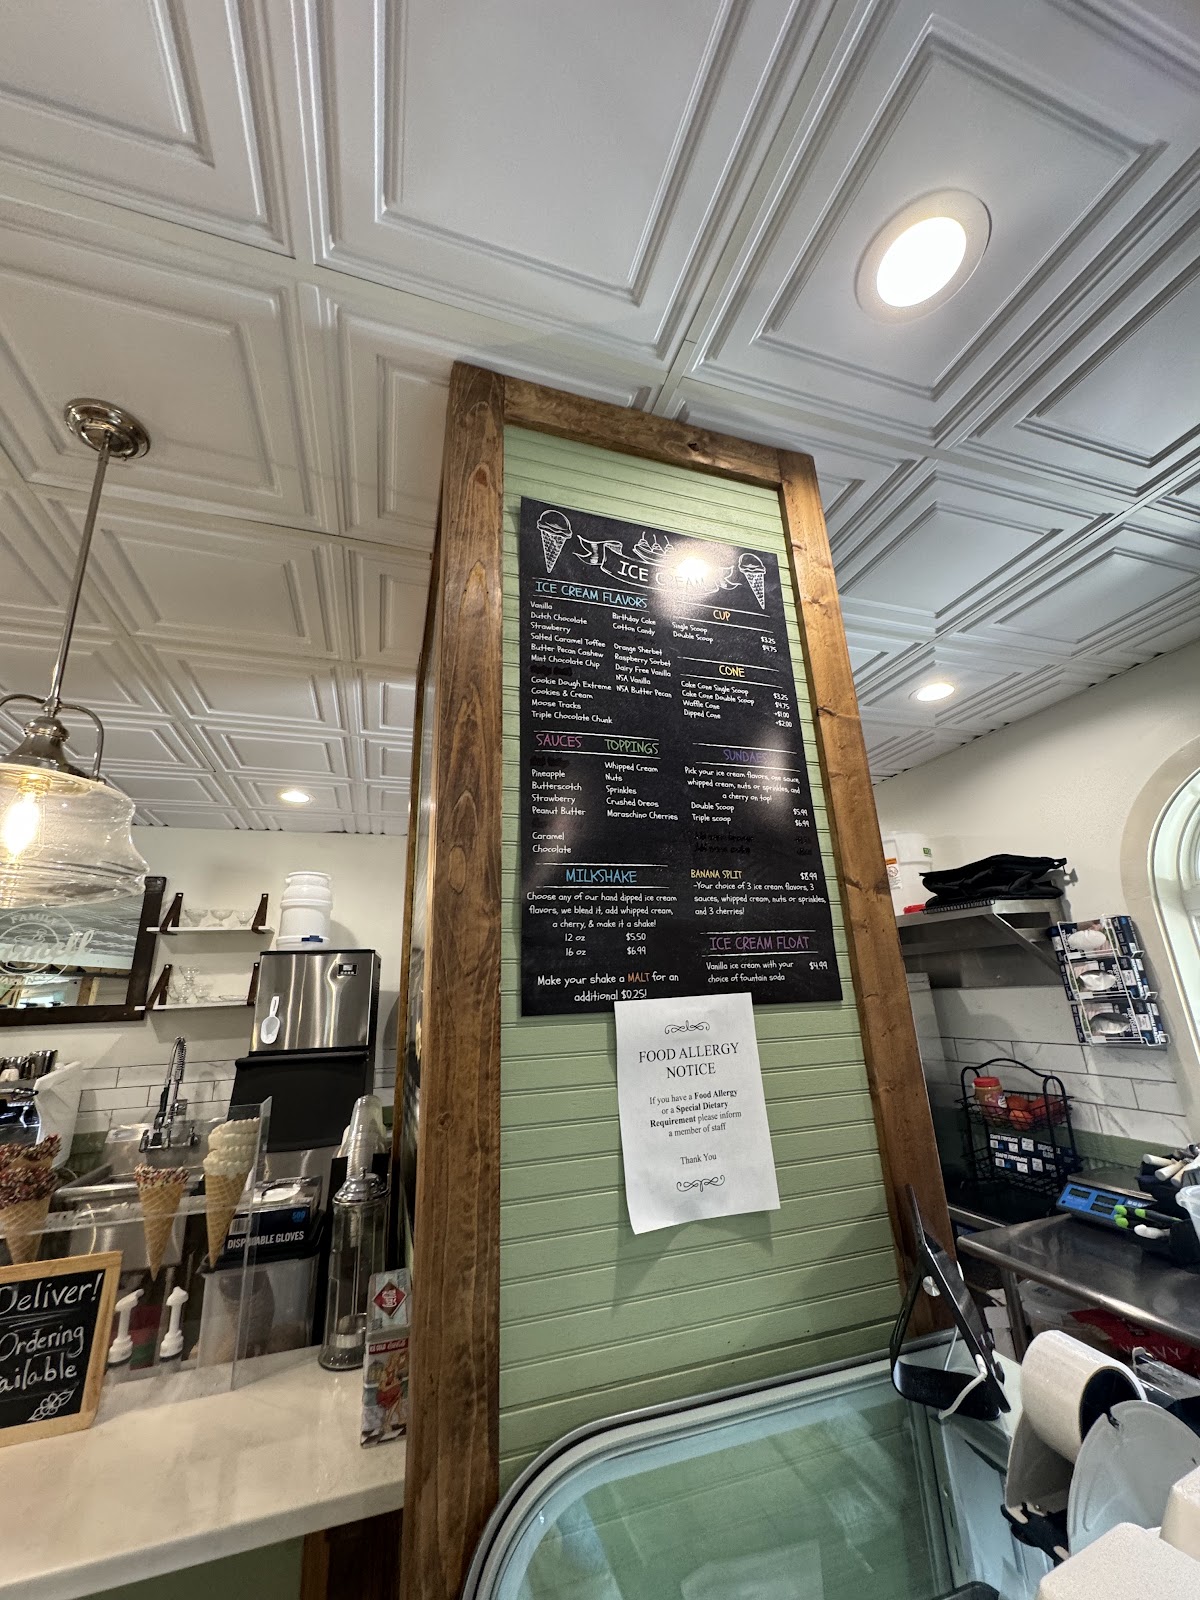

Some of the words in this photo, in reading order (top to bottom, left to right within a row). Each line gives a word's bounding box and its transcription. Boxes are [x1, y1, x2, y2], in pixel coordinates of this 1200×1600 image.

[618, 560, 649, 581] ICE
[535, 581, 556, 592] ICE
[562, 586, 598, 600] CREAM
[603, 592, 648, 608] FLAVORS
[530, 602, 552, 610] Vanilla
[531, 612, 551, 620] Dutch
[554, 615, 587, 624] Chocolate
[612, 613, 639, 624] Birthday
[641, 617, 656, 625] Cake
[713, 610, 730, 621] CUP
[531, 623, 571, 634] Strawberry
[613, 623, 635, 632] Cotton
[637, 627, 655, 636] Candy
[672, 622, 688, 633] Single
[690, 625, 708, 634] Scoop
[531, 633, 552, 641] Salted
[554, 636, 582, 644] Caramel
[585, 639, 606, 648] Toffee
[673, 631, 694, 640] Double
[696, 634, 713, 644] Scoop
[531, 644, 554, 652] Butter
[558, 646, 576, 654] Pecan
[578, 649, 604, 658] Cashew
[614, 643, 636, 653] Orange
[638, 646, 662, 656] Sherbet
[548, 656, 583, 666] Chocolate
[585, 660, 600, 669] Chip
[615, 653, 648, 666] Raspberry
[649, 658, 671, 667] Sorbet
[615, 664, 633, 674] Dairy
[635, 666, 649, 674] Free
[651, 668, 671, 677] Vanilla
[719, 665, 746, 677] CONE
[558, 679, 580, 689] Dough
[583, 682, 612, 691] Extreme
[531, 687, 560, 696] Cookies
[570, 691, 593, 699] Cream
[617, 685, 629, 693] NSA
[631, 687, 653, 696] Butter
[655, 690, 672, 698] Pecan
[531, 699, 556, 707] Moose
[558, 701, 581, 709] Tracks
[683, 700, 703, 708] Waffle
[532, 711, 551, 719] Triple
[554, 712, 590, 721] Chocolate
[592, 715, 612, 724] Chunk
[684, 709, 704, 718] Dipped
[706, 711, 721, 719] Cone
[536, 734, 582, 748] SAUCES
[605, 739, 659, 754] TOPPINGS
[605, 762, 634, 772] Whipped
[636, 764, 658, 772] Cream
[531, 769, 565, 779] Pineapple
[531, 781, 582, 790] Butterscotch
[606, 786, 637, 794] Sprinkles
[532, 794, 576, 804] Strawberry
[606, 797, 635, 806] Crushed
[532, 806, 558, 814] Peanut
[561, 807, 586, 815] Butter
[691, 802, 714, 810] Double
[716, 804, 734, 813] Scoop
[607, 809, 647, 818] Maraschino
[649, 812, 678, 820] Cherries
[692, 814, 710, 823] Triple
[712, 816, 731, 825] scoop
[532, 832, 565, 840] Caramel
[532, 845, 571, 853] Chocolate
[566, 868, 637, 883] MILKSHAKE
[691, 869, 720, 879] BANANA
[722, 870, 742, 879] SPLIT
[527, 892, 556, 901] Choose
[558, 894, 571, 903] any
[574, 892, 584, 900] of
[601, 892, 618, 901] hand
[620, 891, 642, 903] dipped
[529, 905, 558, 915] flavors,
[574, 906, 593, 914] blend
[595, 906, 603, 915] it,
[605, 906, 618, 914] add
[620, 906, 648, 917] whipped
[565, 933, 573, 941] 12
[626, 933, 646, 941] $5.50
[709, 937, 731, 950] ICE
[735, 936, 772, 950] CREAM
[776, 936, 809, 949] FLOAT
[565, 948, 574, 956] 16
[627, 946, 646, 955] $6.99
[706, 962, 728, 970] Vanilla
[778, 961, 793, 971] your
[809, 961, 828, 970] $4.99
[538, 975, 561, 986] Make
[564, 976, 585, 988] your
[590, 973, 616, 984] shake
[628, 972, 650, 982] MALT
[652, 971, 666, 982] for
[669, 974, 679, 982] an
[708, 974, 728, 983] choice
[731, 973, 739, 982] of
[740, 974, 767, 982] fountain
[769, 973, 785, 981] soda
[574, 990, 618, 1002] additional
[621, 989, 647, 999] $0.25!
[639, 1048, 676, 1064] FOOD
[679, 1042, 740, 1059] ALLERGY
[667, 1062, 716, 1079] NOTICE
[650, 1096, 655, 1105] If
[657, 1095, 670, 1105] you
[671, 1093, 687, 1102] have
[694, 1091, 711, 1100] Food
[713, 1089, 738, 1099] Allergy
[676, 1102, 701, 1114] Special
[703, 1100, 728, 1111] Dietary
[650, 1115, 696, 1129] Requirement
[698, 1114, 718, 1125] please
[719, 1110, 742, 1120] inform
[674, 1126, 701, 1136] member
[703, 1124, 710, 1132] of
[711, 1122, 726, 1132] staff
[680, 1154, 702, 1165] Thank
[703, 1153, 717, 1162] You
[227, 1235, 274, 1249] DISPABLE
[276, 1231, 304, 1242] GLOVES
[0, 1326, 84, 1362] Ordering
[0, 1352, 77, 1393] ailable
